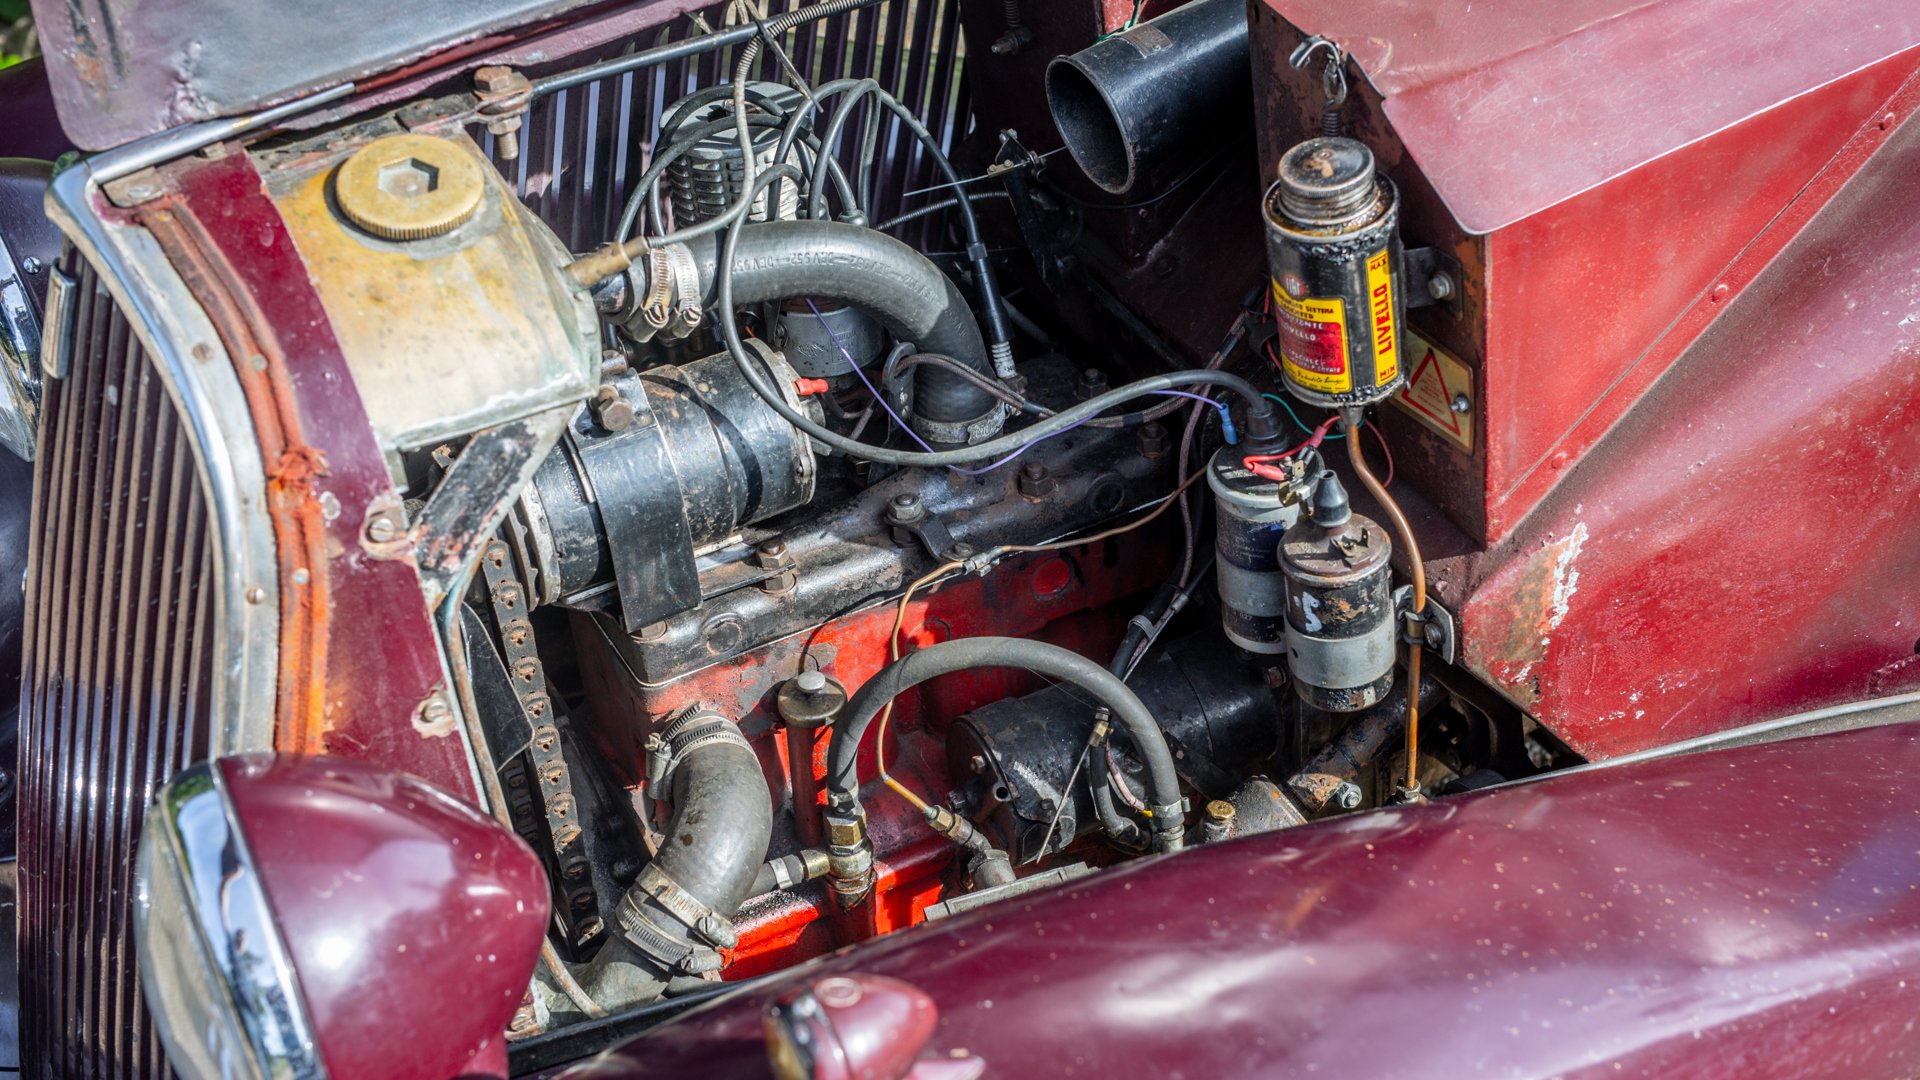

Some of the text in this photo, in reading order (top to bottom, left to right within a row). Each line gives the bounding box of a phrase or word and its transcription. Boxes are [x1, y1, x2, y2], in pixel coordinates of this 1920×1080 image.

[1306, 305, 1334, 314] SISTEMA
[1373, 283, 1393, 355] LIVELLO
[1379, 364, 1395, 379] MIN
